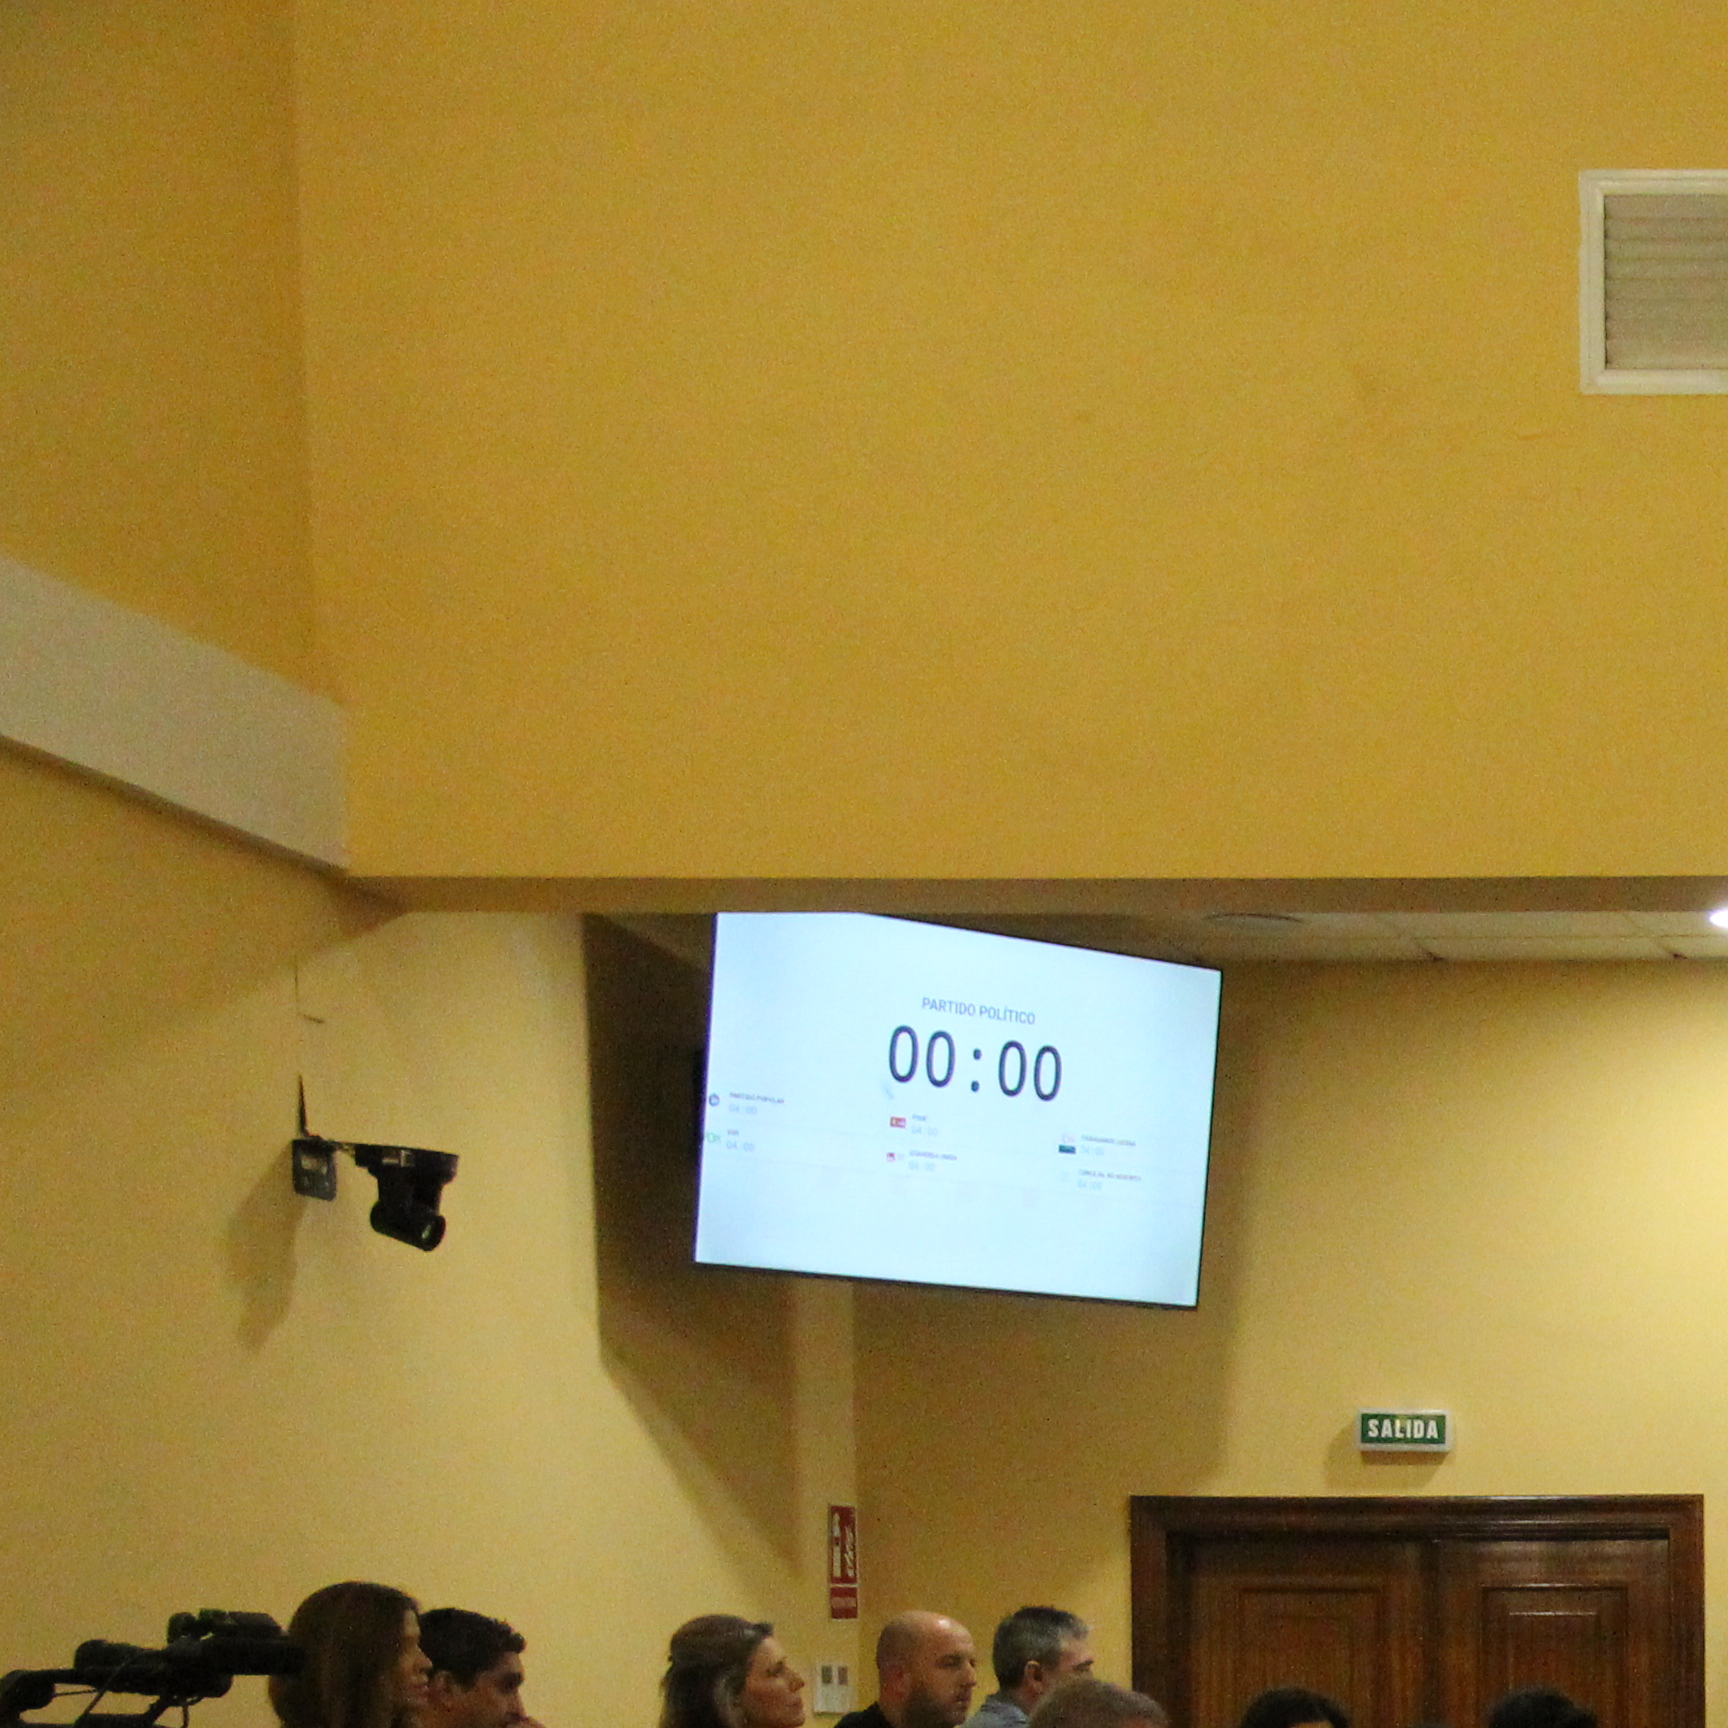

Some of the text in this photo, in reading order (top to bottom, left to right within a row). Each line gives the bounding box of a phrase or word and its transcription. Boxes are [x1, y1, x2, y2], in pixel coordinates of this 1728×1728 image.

[922, 997, 1036, 1026] PARTIDO POLÍTICO
[889, 1024, 1062, 1101] 00:00
[1368, 1418, 1439, 1439] SALIDA
